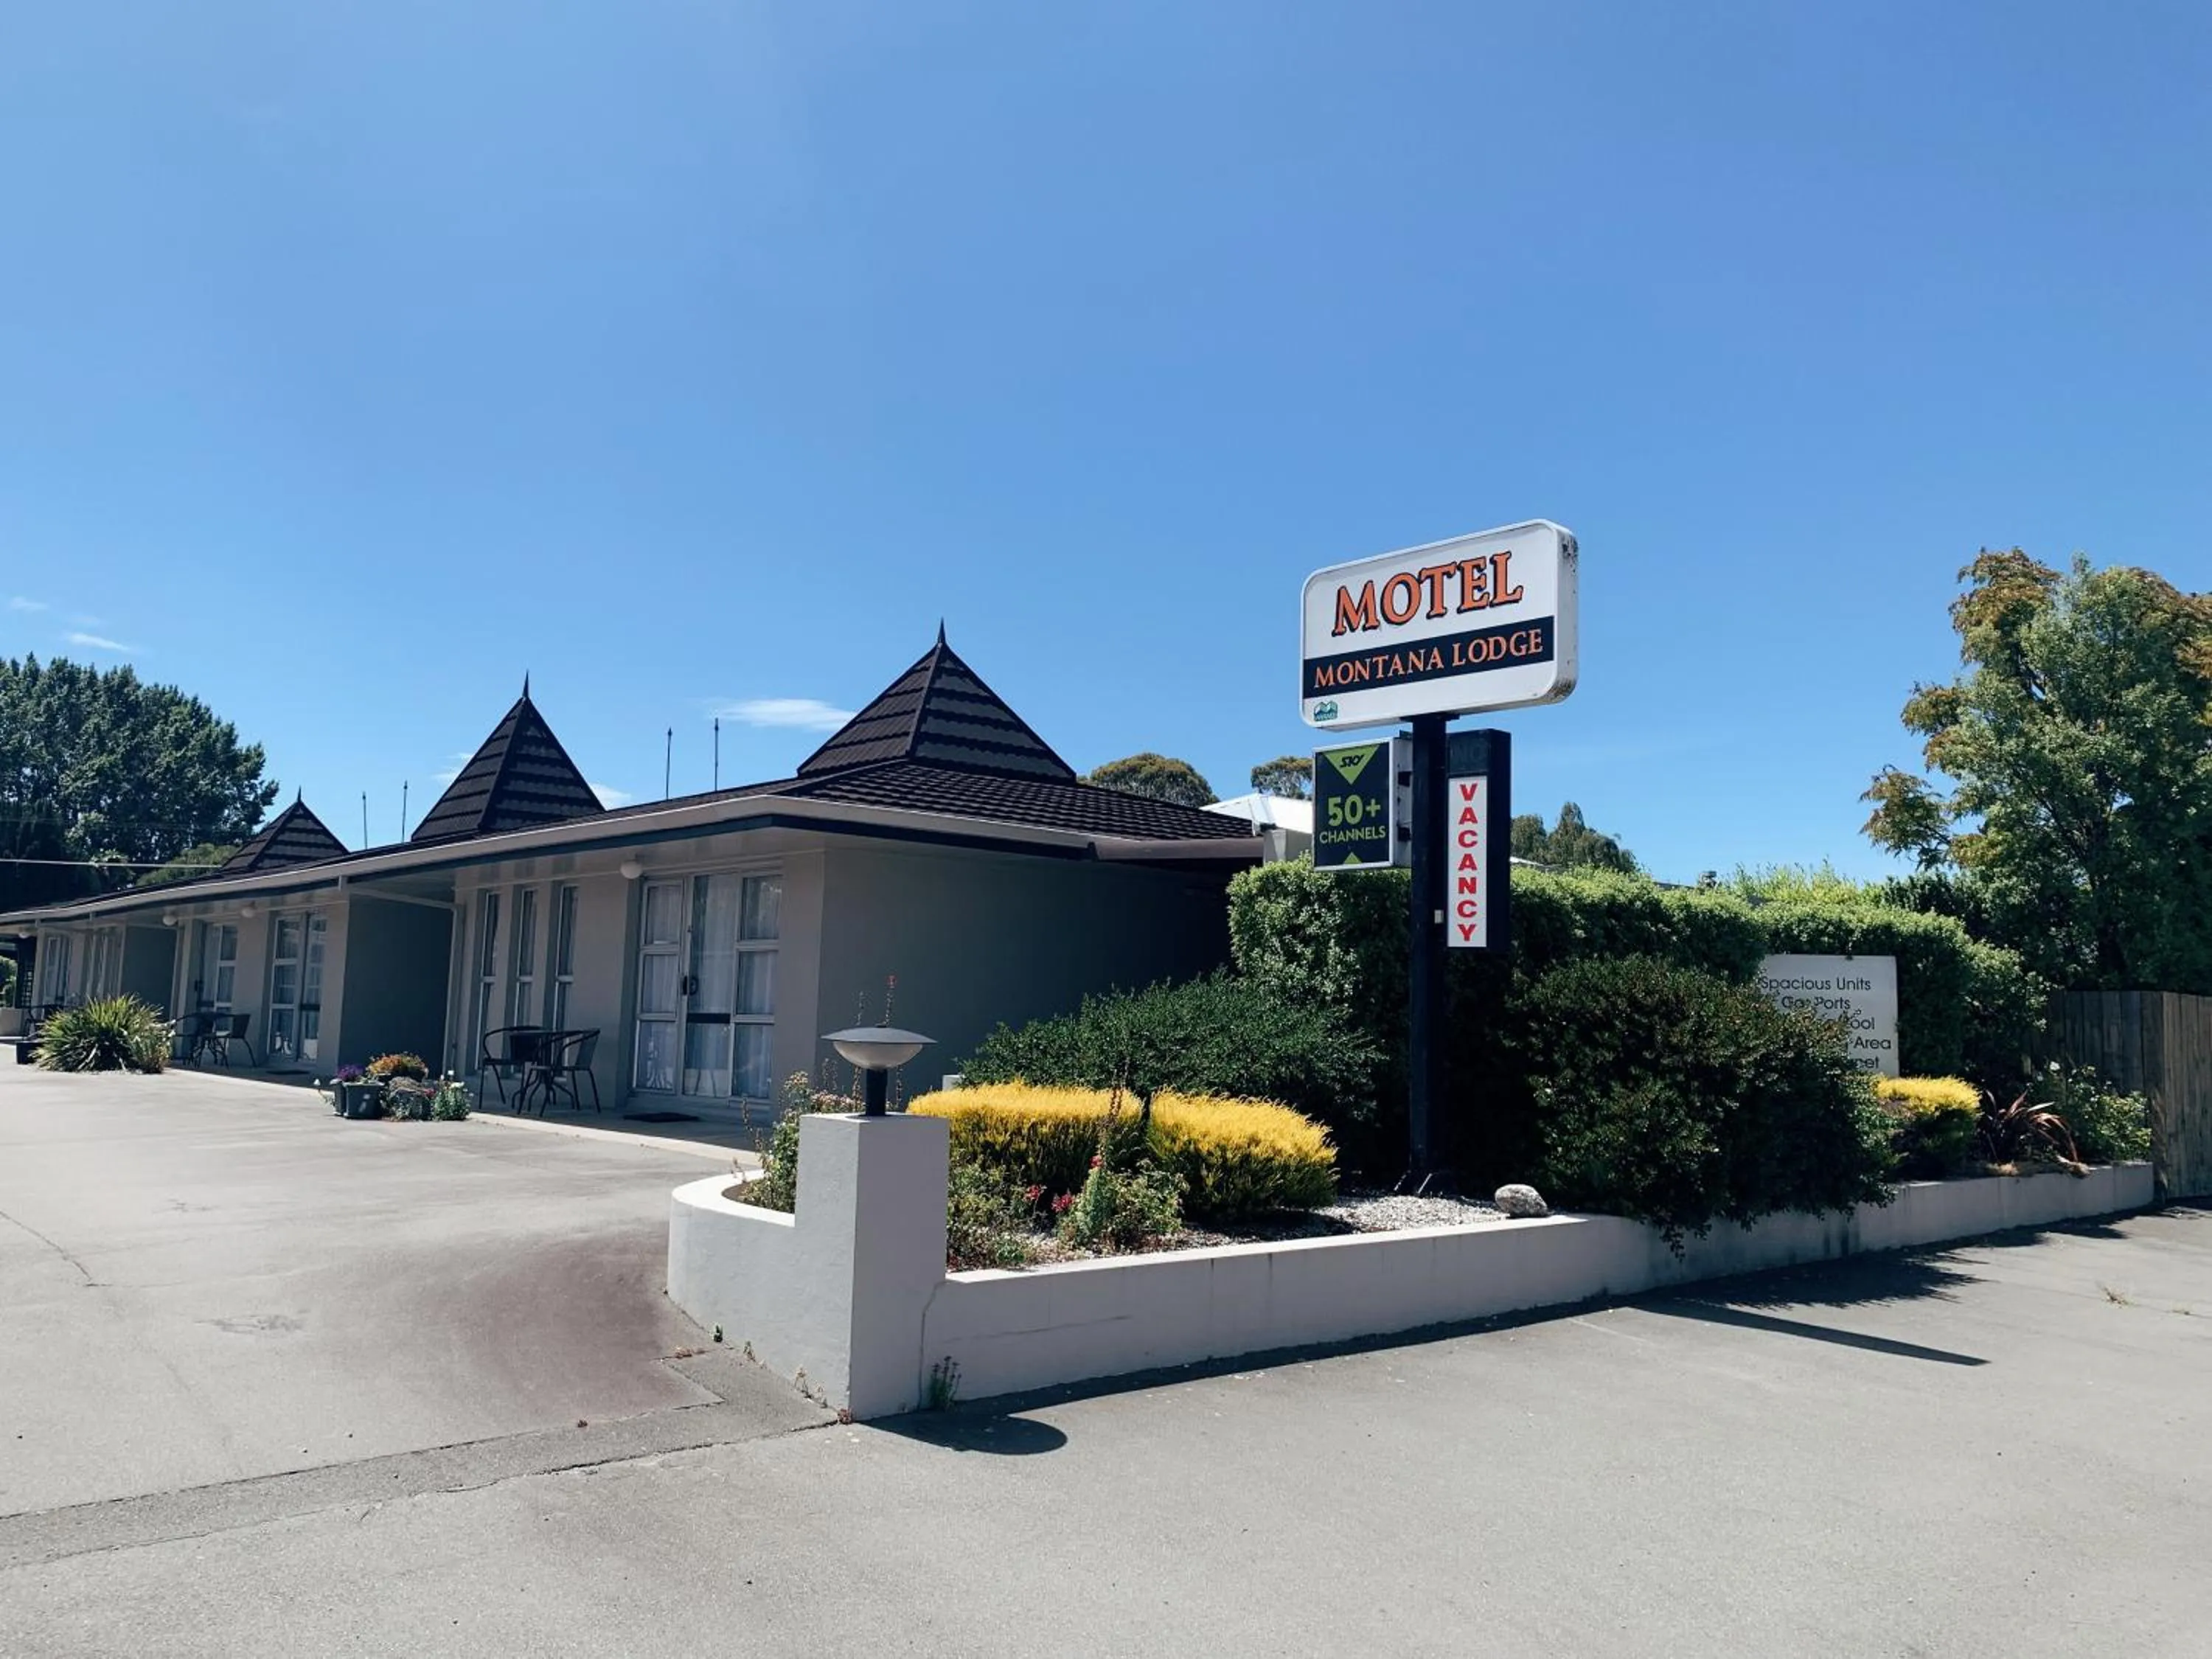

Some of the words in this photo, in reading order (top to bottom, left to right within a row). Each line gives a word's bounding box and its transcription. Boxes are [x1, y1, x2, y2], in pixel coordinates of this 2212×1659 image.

[1331, 551, 1523, 636] MOTEL
[1315, 647, 1444, 689] MONTANA
[1452, 629, 1543, 666] LODGE
[1339, 754, 1365, 768] SKY
[1328, 795, 1381, 827] 50+
[1319, 825, 1385, 844] CHANNELS
[1456, 782, 1478, 942] VACANCY
[1760, 976, 1832, 993] Spacious
[1837, 976, 1871, 991] Units
[1845, 1017, 1875, 1030] ool
[1853, 1036, 1891, 1050] Area
